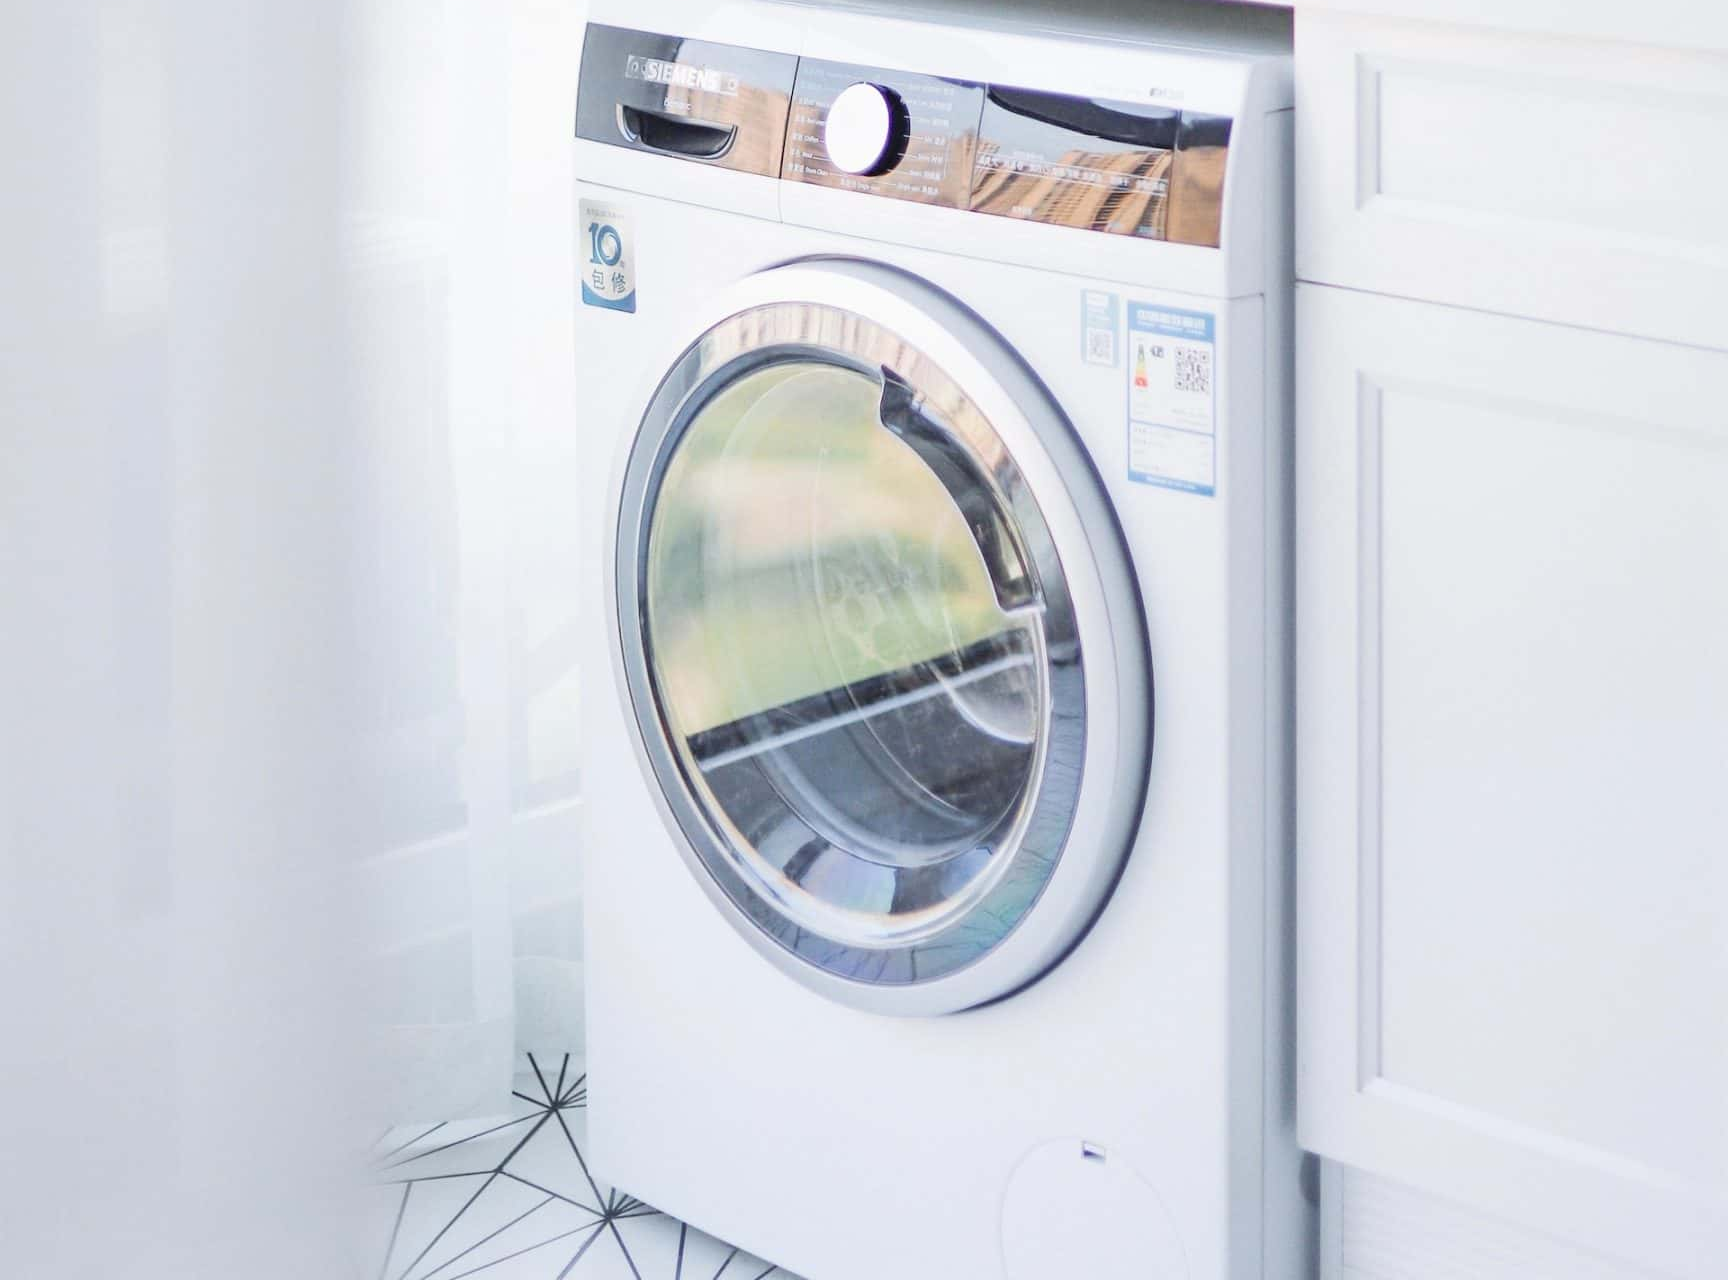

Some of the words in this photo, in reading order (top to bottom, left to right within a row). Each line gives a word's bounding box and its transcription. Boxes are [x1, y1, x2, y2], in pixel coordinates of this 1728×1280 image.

[647, 61, 721, 89] SIEMENS
[588, 221, 622, 266] 10
[592, 269, 626, 294] 包修
